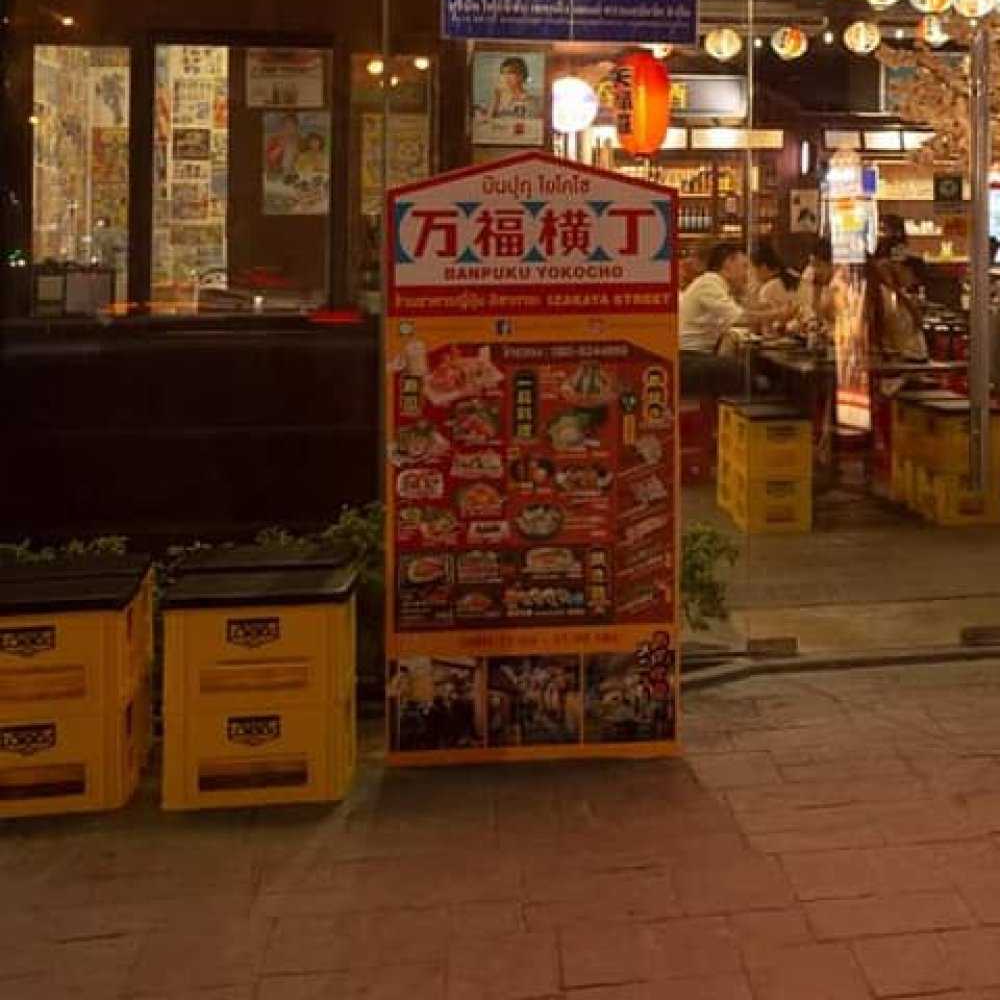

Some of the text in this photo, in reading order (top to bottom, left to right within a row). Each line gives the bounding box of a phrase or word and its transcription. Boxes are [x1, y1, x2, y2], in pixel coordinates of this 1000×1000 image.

[410, 207, 656, 257] 万福横丁
[444, 264, 624, 281] BANPUKU YOKOCHO
